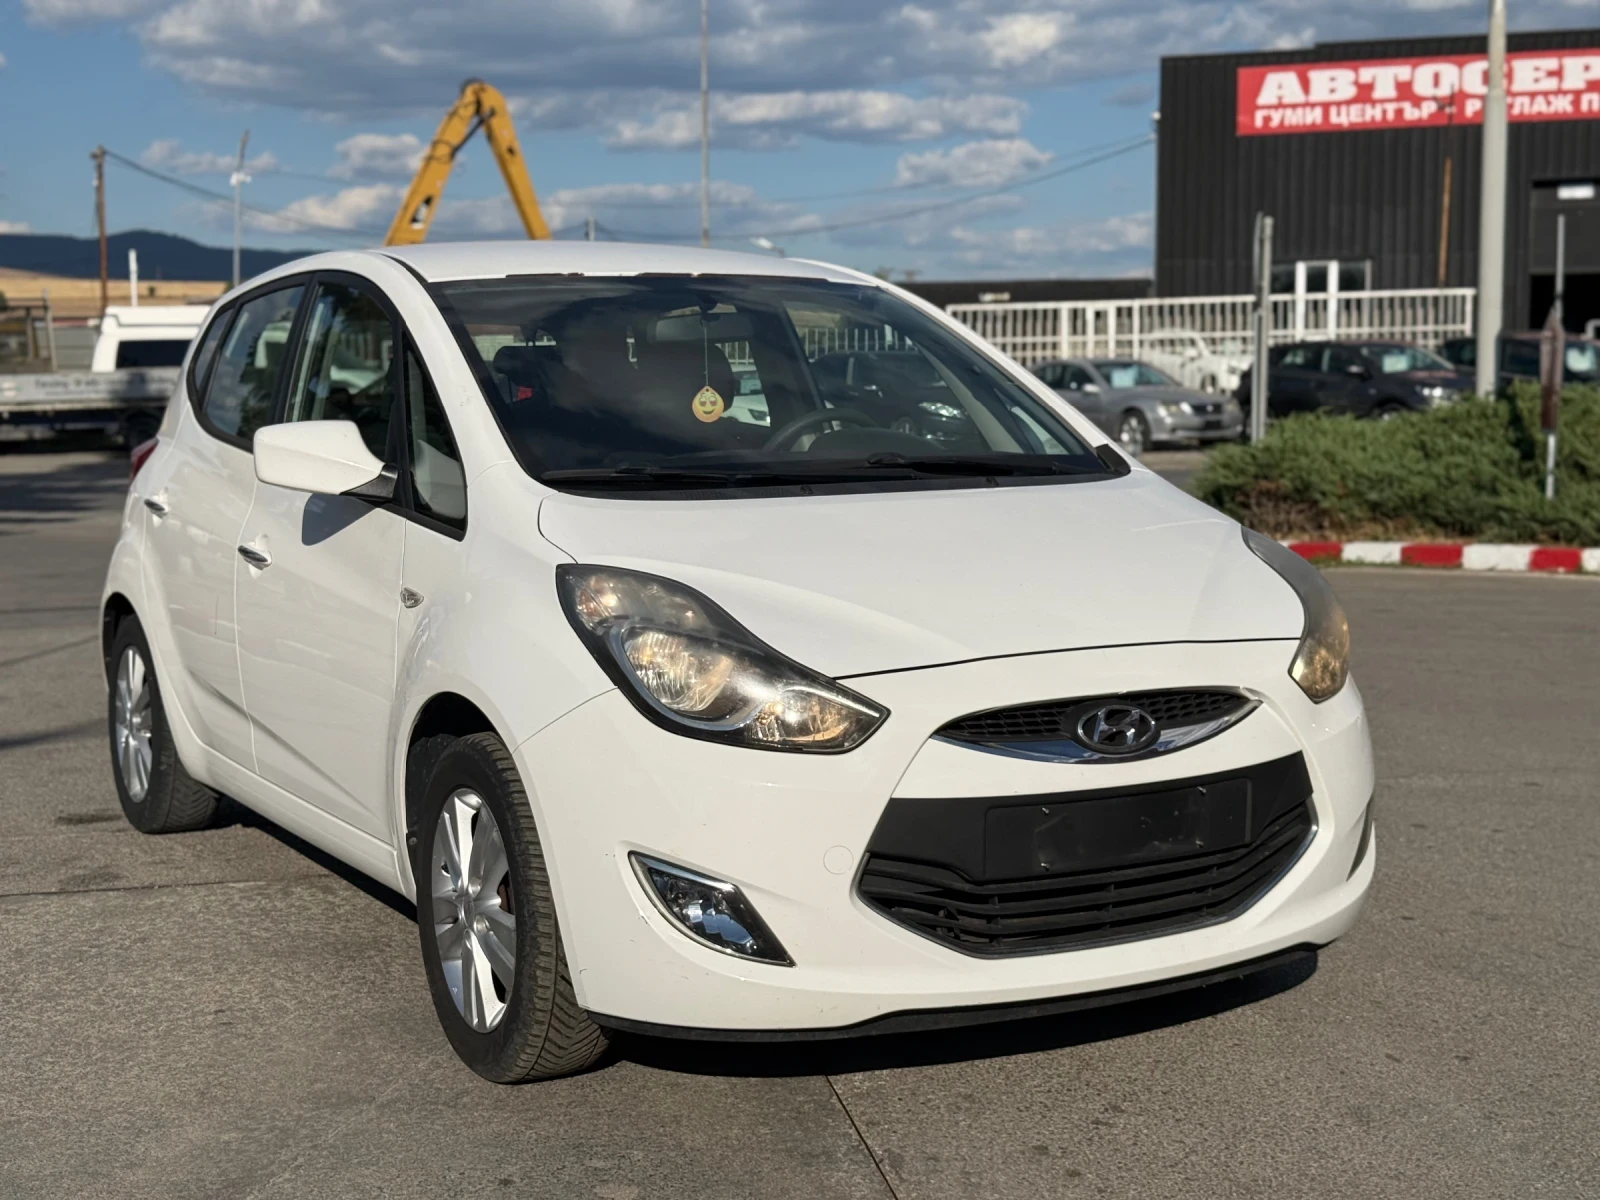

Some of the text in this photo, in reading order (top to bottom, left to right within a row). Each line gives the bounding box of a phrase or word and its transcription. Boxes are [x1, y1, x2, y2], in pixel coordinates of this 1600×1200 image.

[1254, 105, 1323, 128] ГУМИ
[1329, 100, 1438, 127] ЦЕНТЪР
[1464, 93, 1574, 118] РЛАЖ
